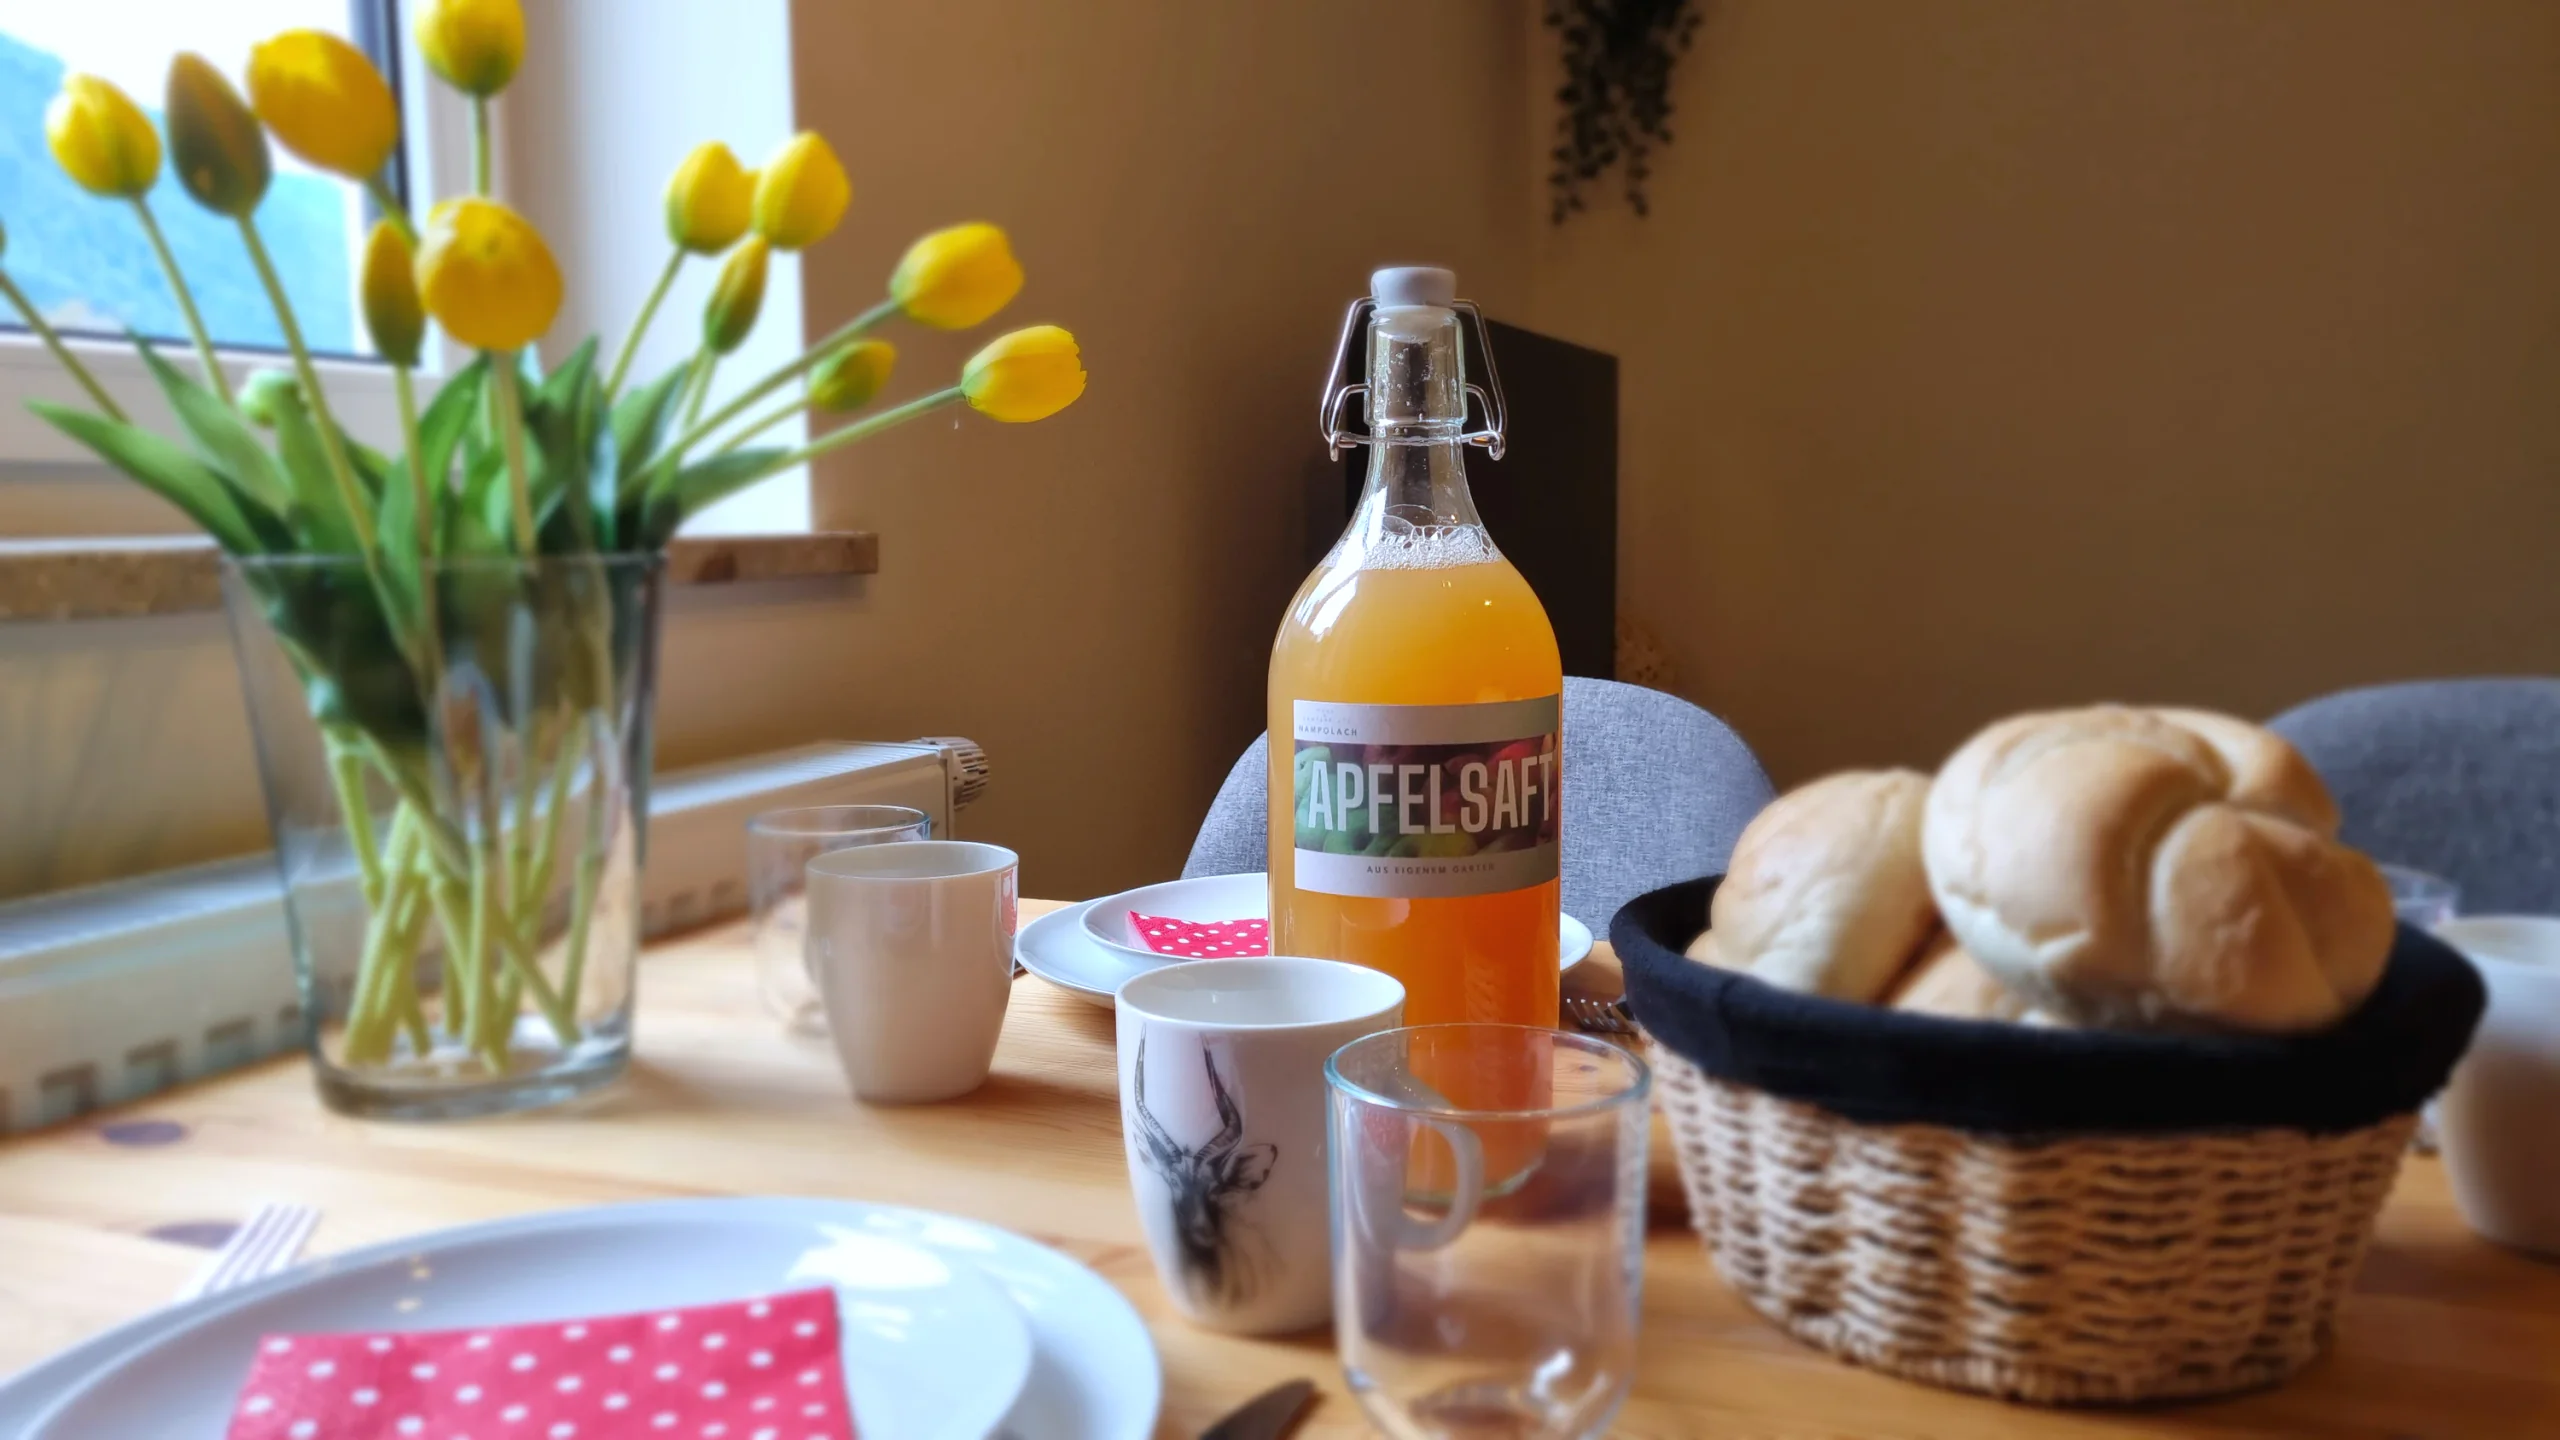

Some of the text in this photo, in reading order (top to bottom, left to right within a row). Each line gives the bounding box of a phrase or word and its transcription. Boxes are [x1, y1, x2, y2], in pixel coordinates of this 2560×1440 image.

[1299, 725, 1357, 736] NAMPOLACH
[1308, 752, 1552, 834] APFELSAFT
[1367, 865, 1389, 874] AUS
[1395, 865, 1446, 874] EIGENEM
